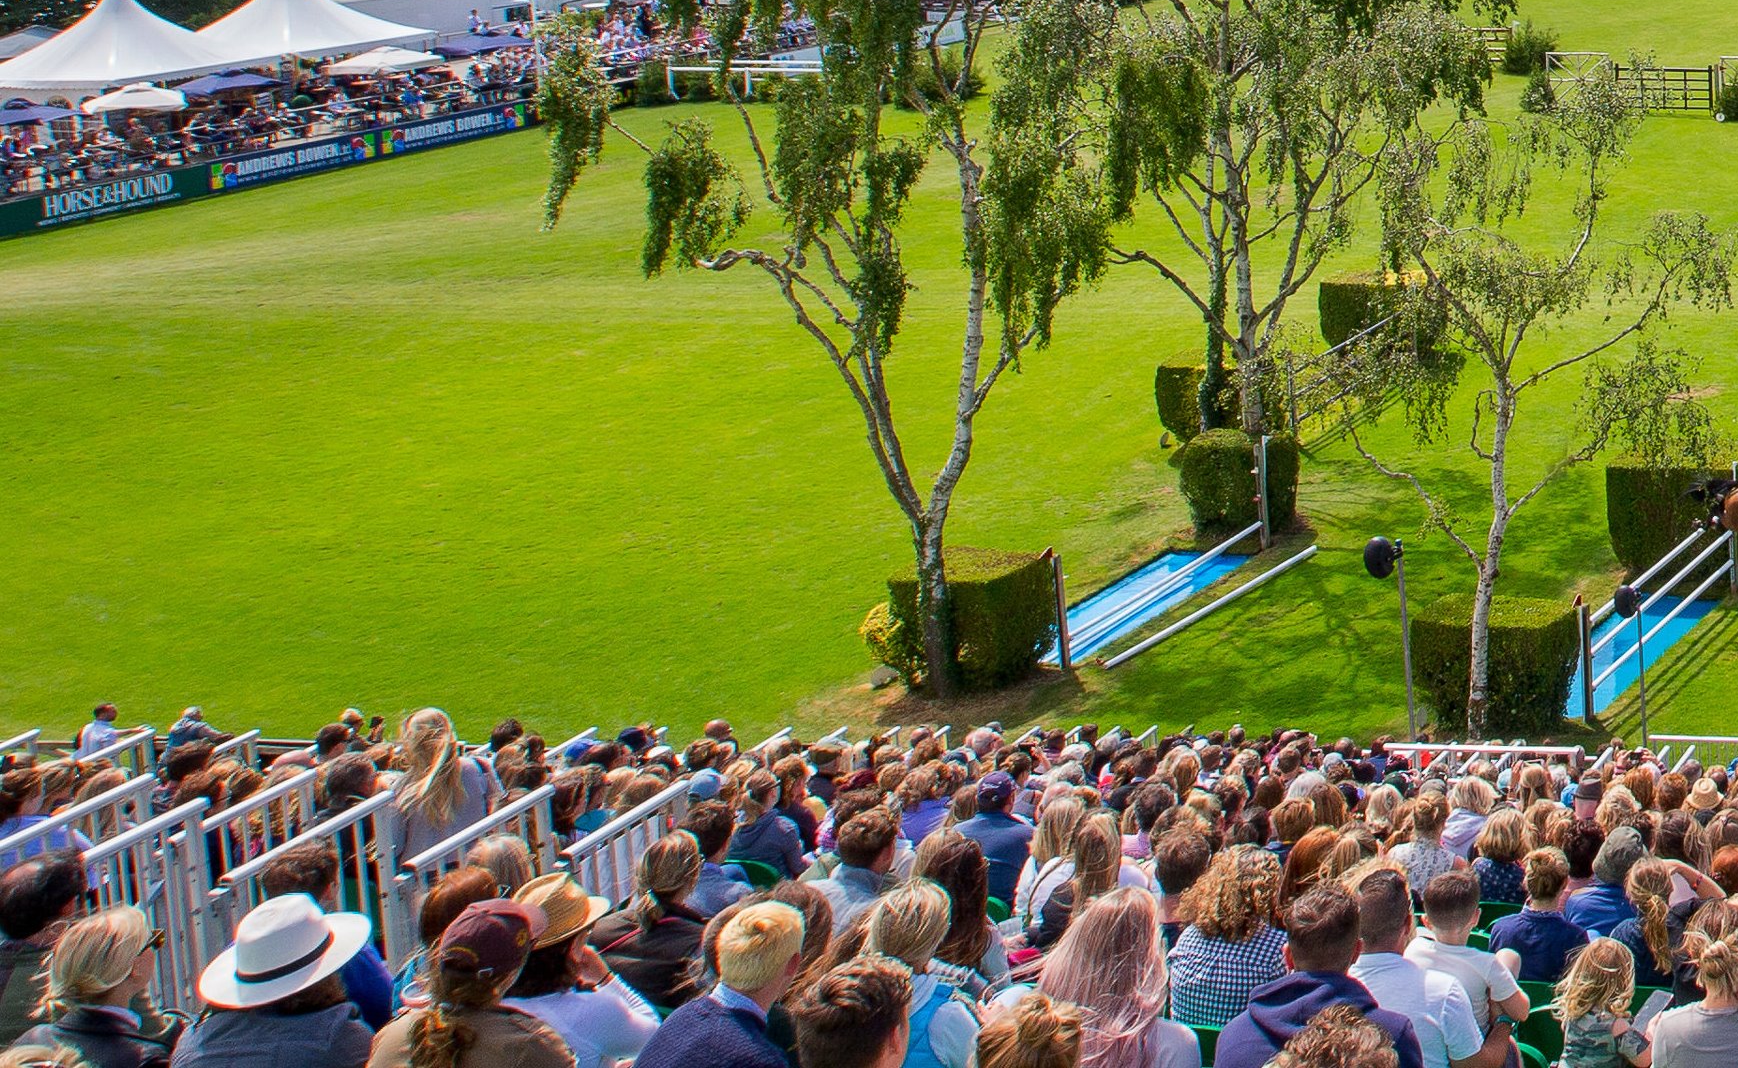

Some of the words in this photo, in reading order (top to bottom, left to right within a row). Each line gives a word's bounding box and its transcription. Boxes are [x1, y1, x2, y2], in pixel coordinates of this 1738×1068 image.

[404, 120, 455, 142] ANDREWS
[237, 151, 296, 176] ANDREWS
[297, 143, 340, 164] BOWEN
